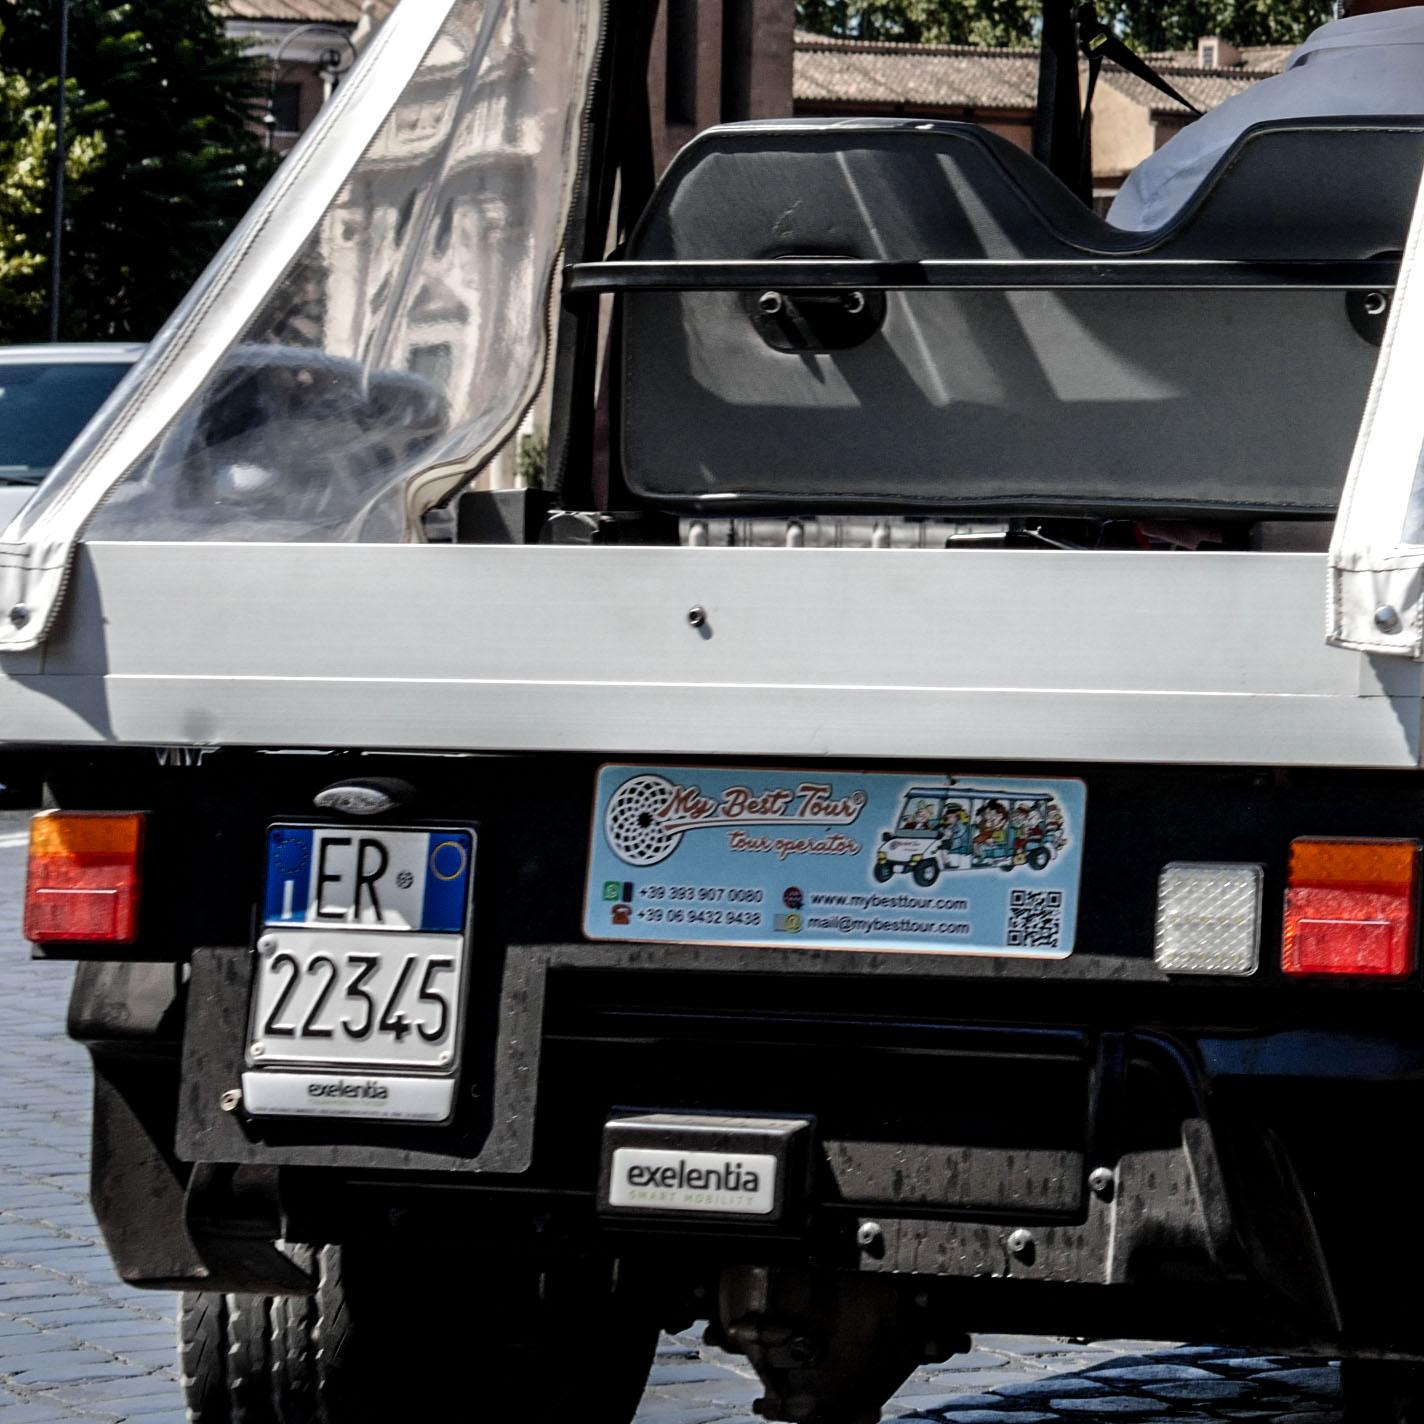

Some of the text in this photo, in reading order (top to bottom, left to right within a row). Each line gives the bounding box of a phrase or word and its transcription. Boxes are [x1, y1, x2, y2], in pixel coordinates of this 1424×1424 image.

[657, 788, 715, 819] My
[723, 788, 793, 817] Best
[728, 831, 772, 852] tour
[772, 833, 861, 860] operator
[315, 836, 389, 923] ER
[639, 886, 666, 900] +39
[698, 888, 726, 902] 907
[810, 893, 968, 911] www.mybesttour.com
[637, 909, 664, 923] +39
[666, 909, 685, 923] 06
[687, 910, 723, 924] 9432
[808, 916, 971, 935] mail@mybesttour.com
[264, 952, 456, 1044] 22345
[306, 1079, 389, 1102] exelentia
[626, 1159, 760, 1193] exelentia
[630, 1190, 756, 1206] SMART MOBILITY
